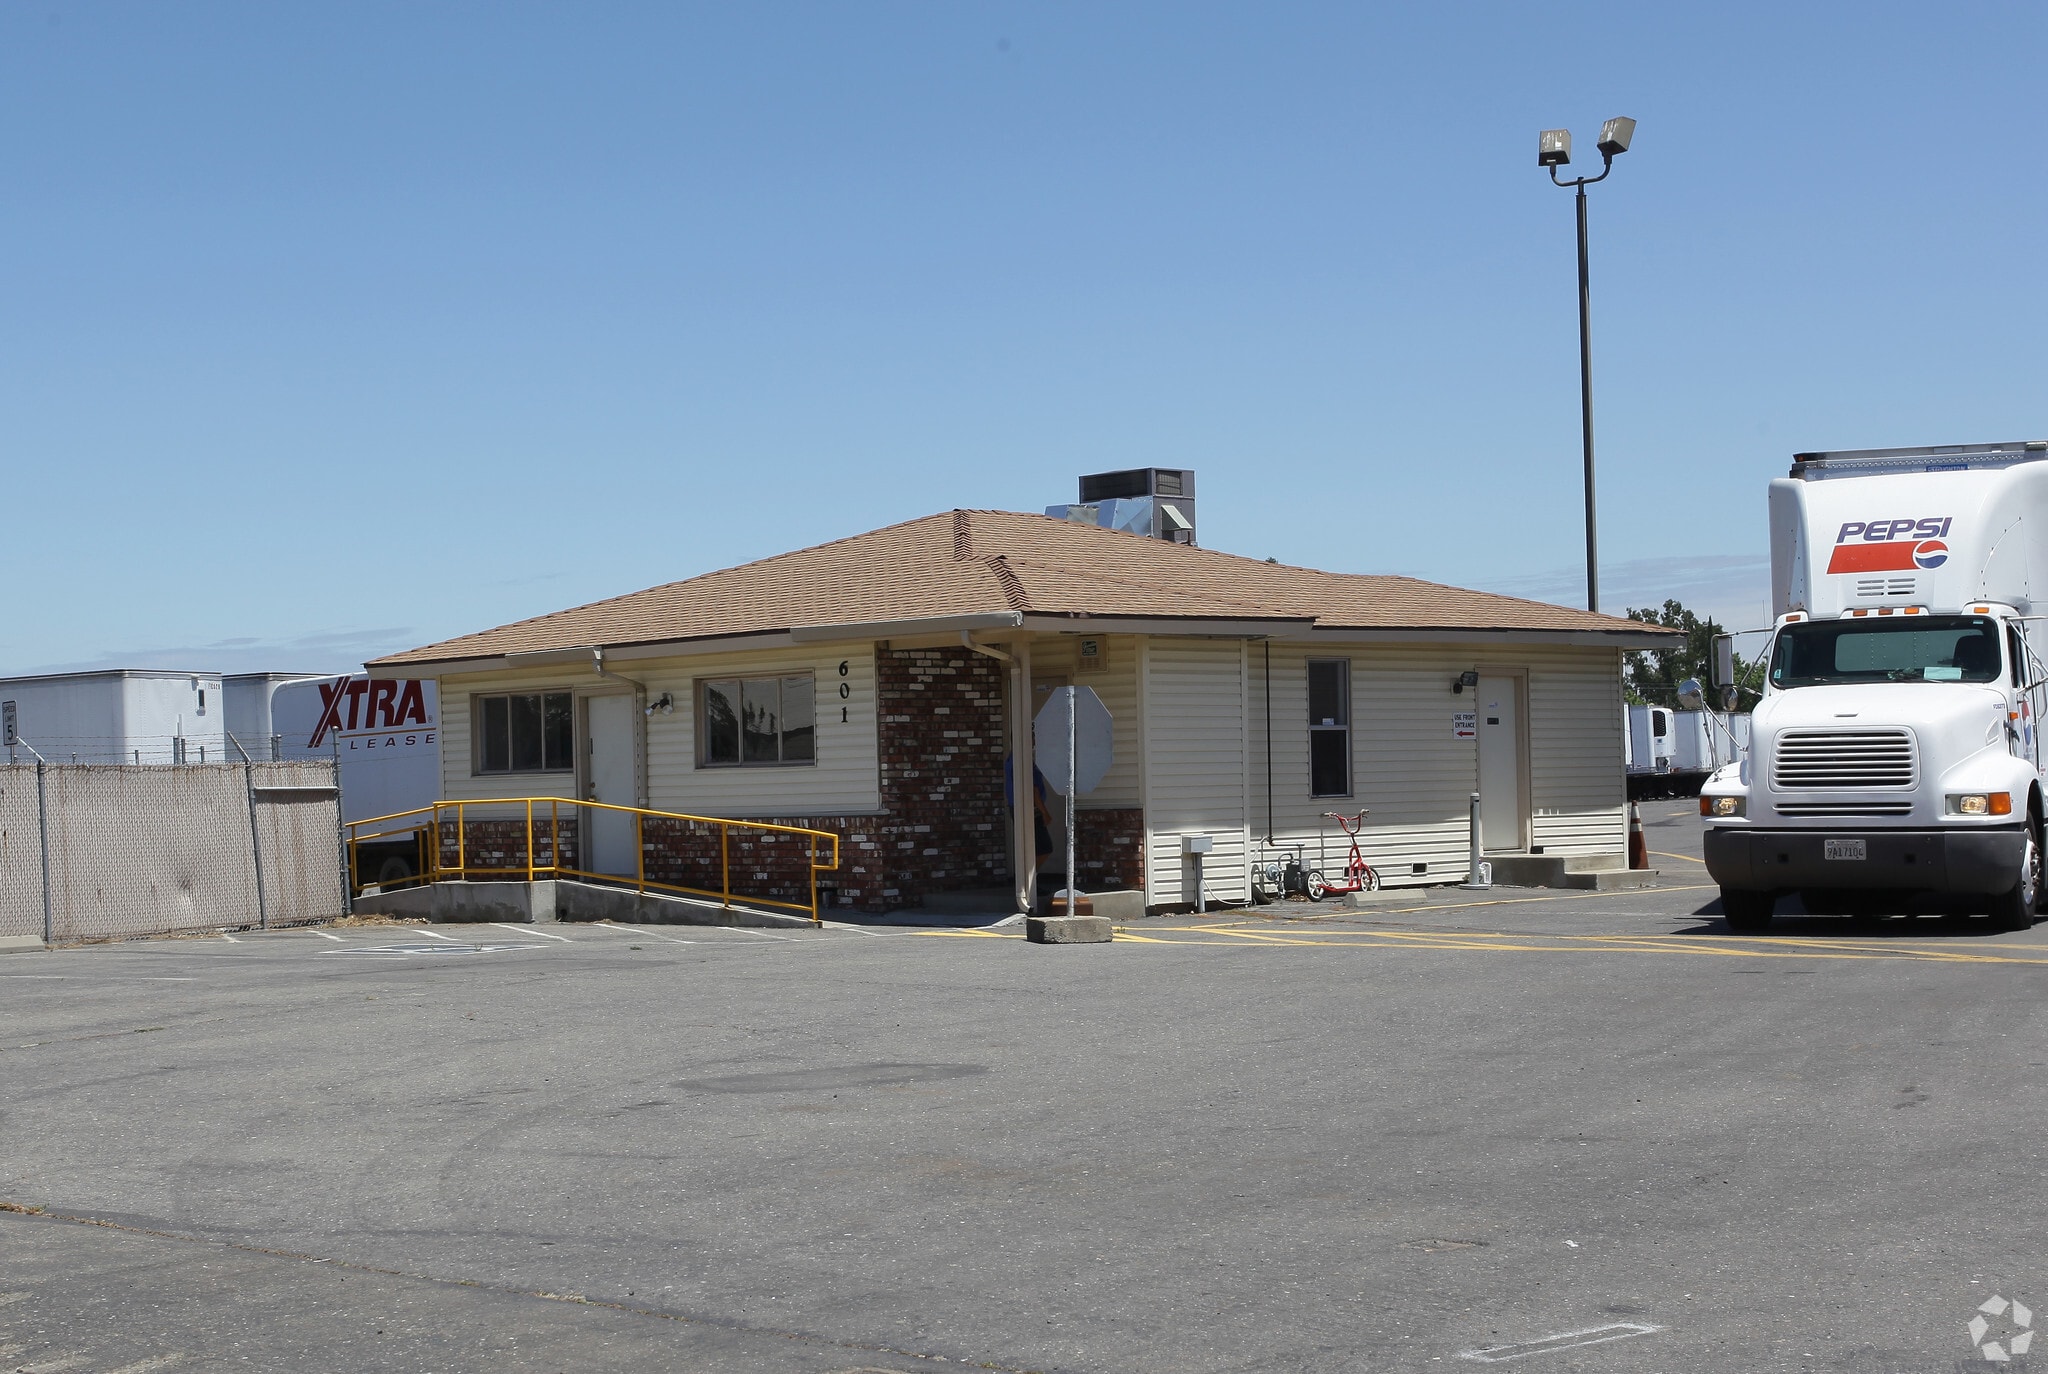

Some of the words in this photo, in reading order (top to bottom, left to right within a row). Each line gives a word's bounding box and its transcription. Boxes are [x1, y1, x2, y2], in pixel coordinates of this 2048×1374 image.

[1836, 516, 1953, 544] PEPSI
[307, 676, 426, 748] XTRA
[7, 724, 14, 740] 5
[350, 734, 436, 750] LEASE
